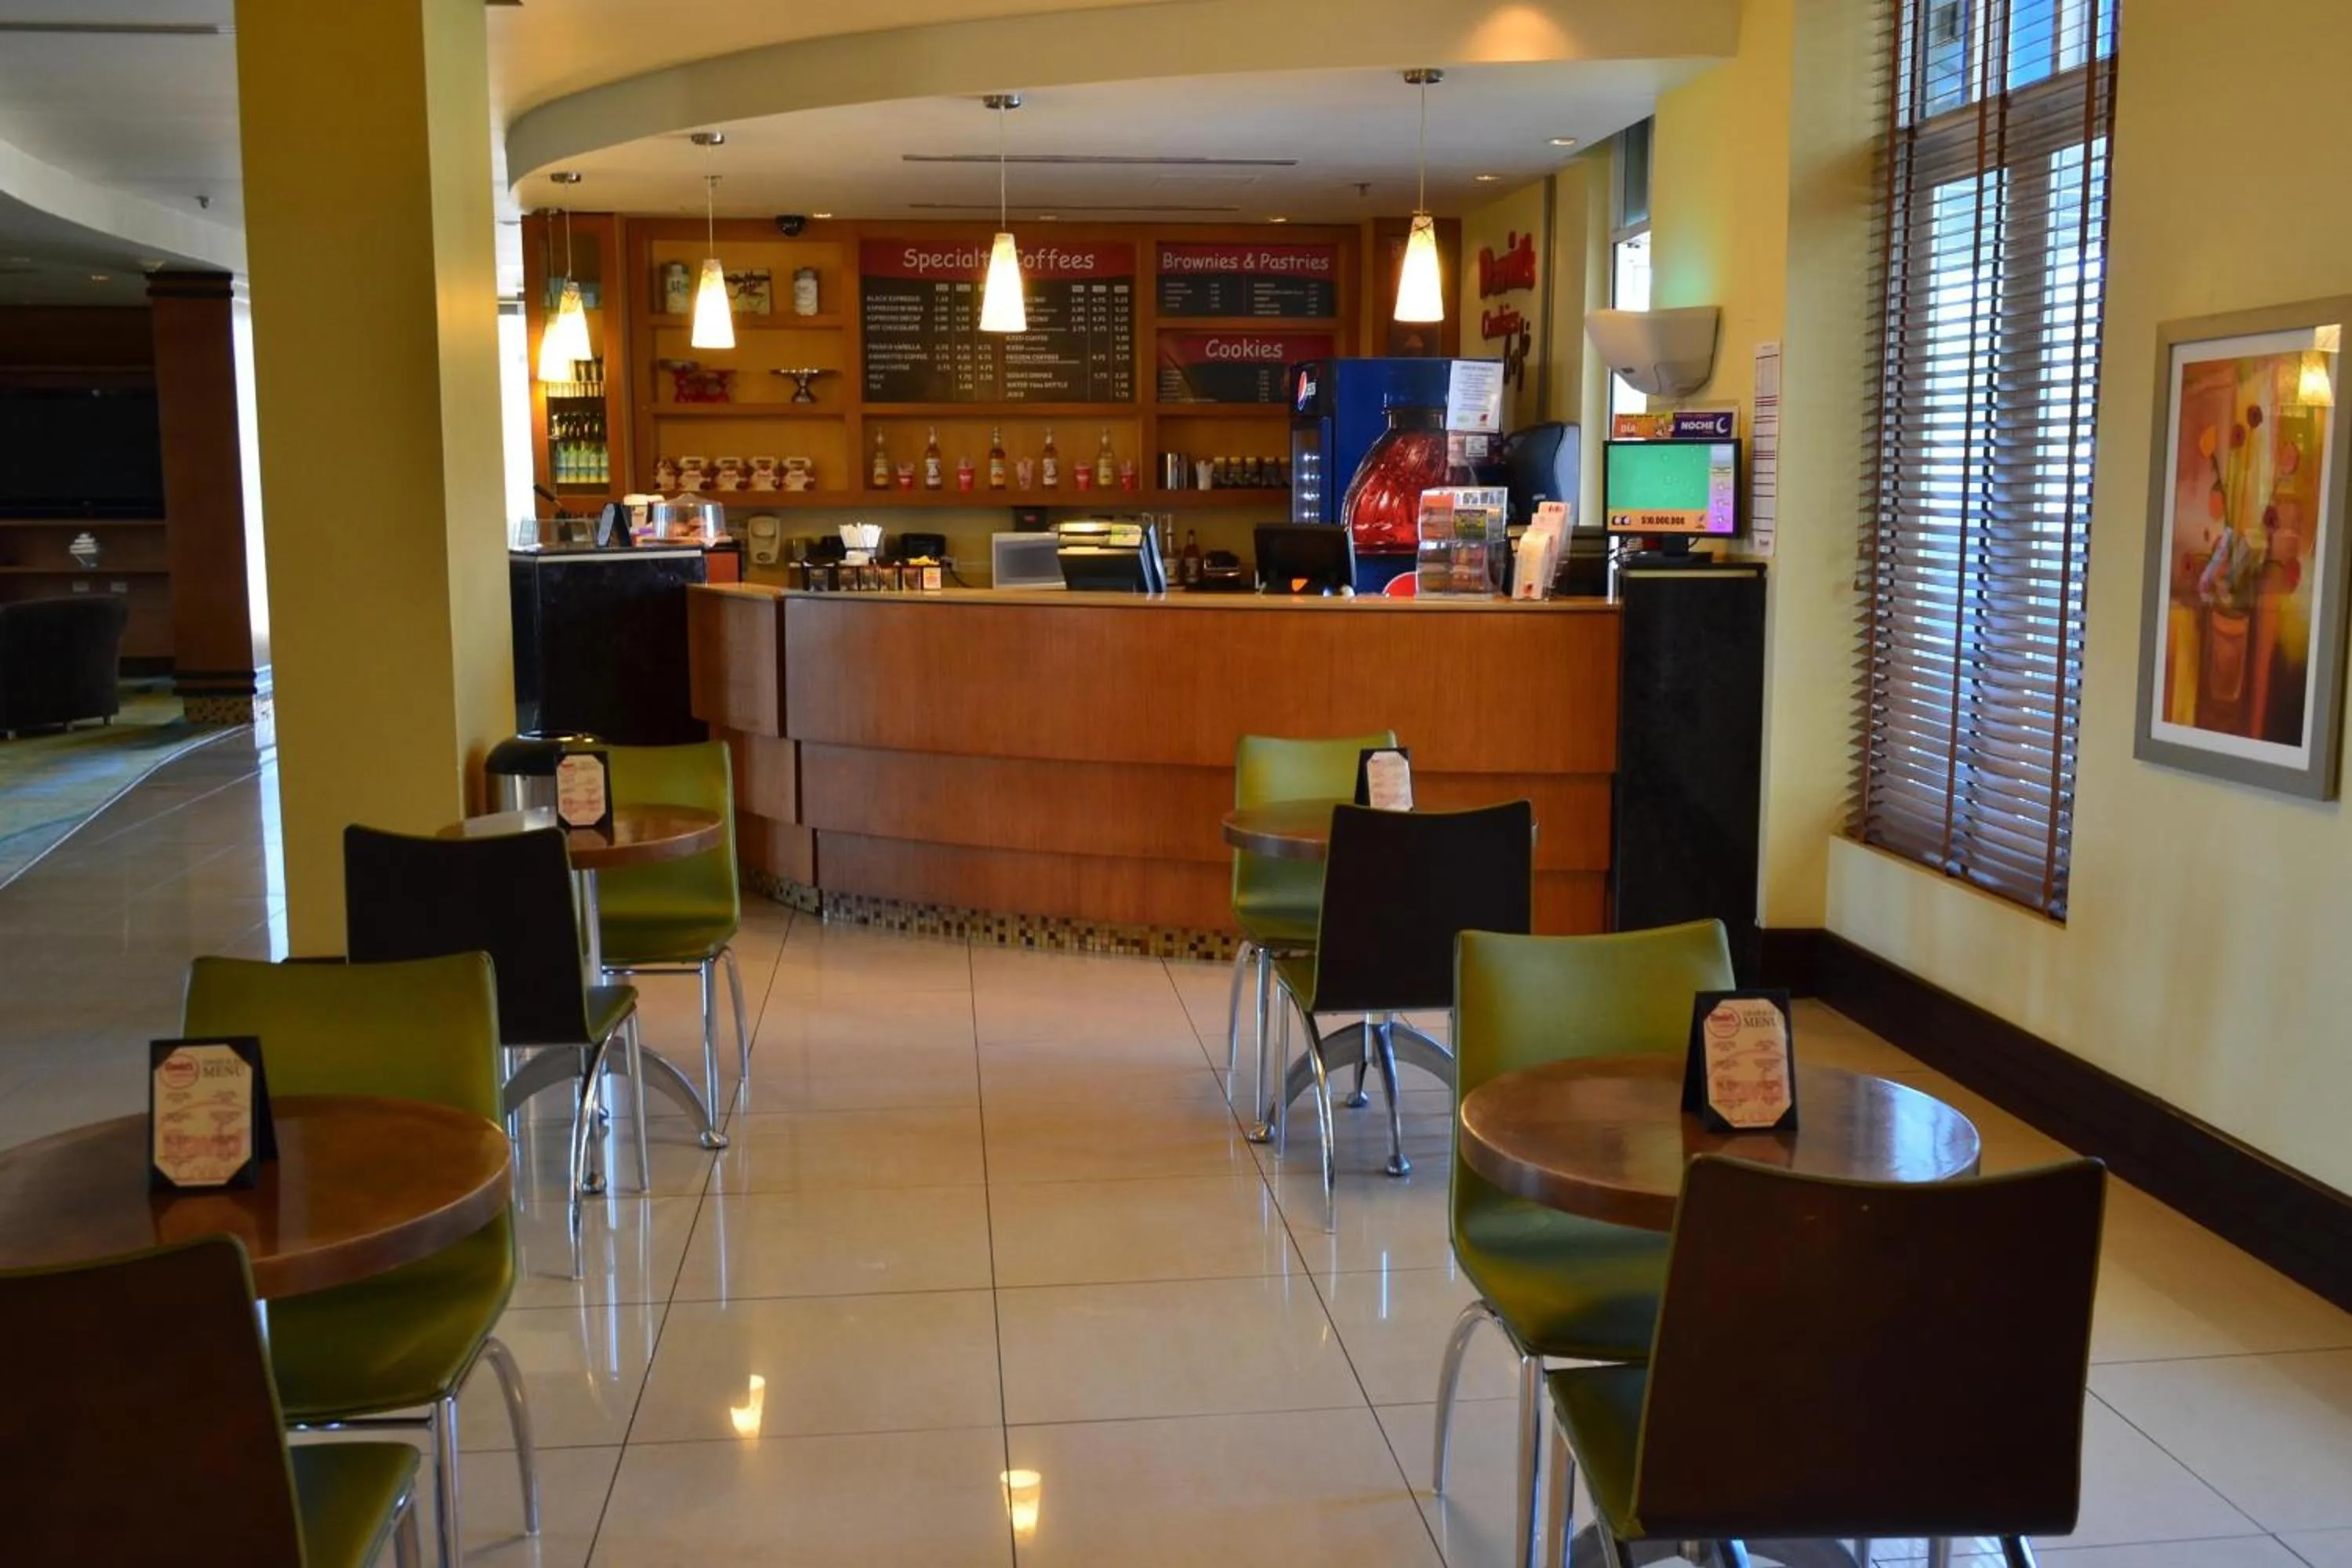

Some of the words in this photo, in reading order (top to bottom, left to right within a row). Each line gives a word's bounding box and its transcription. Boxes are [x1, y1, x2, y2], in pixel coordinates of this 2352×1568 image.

[902, 248, 991, 273] Specialt
[1162, 252, 1238, 270] Brownies
[1243, 252, 1255, 270] &
[1259, 253, 1330, 270] Pastries
[1205, 338, 1283, 358] Cookies
[1680, 420, 1715, 430] NOCHE
[202, 1065, 244, 1079] MENU
